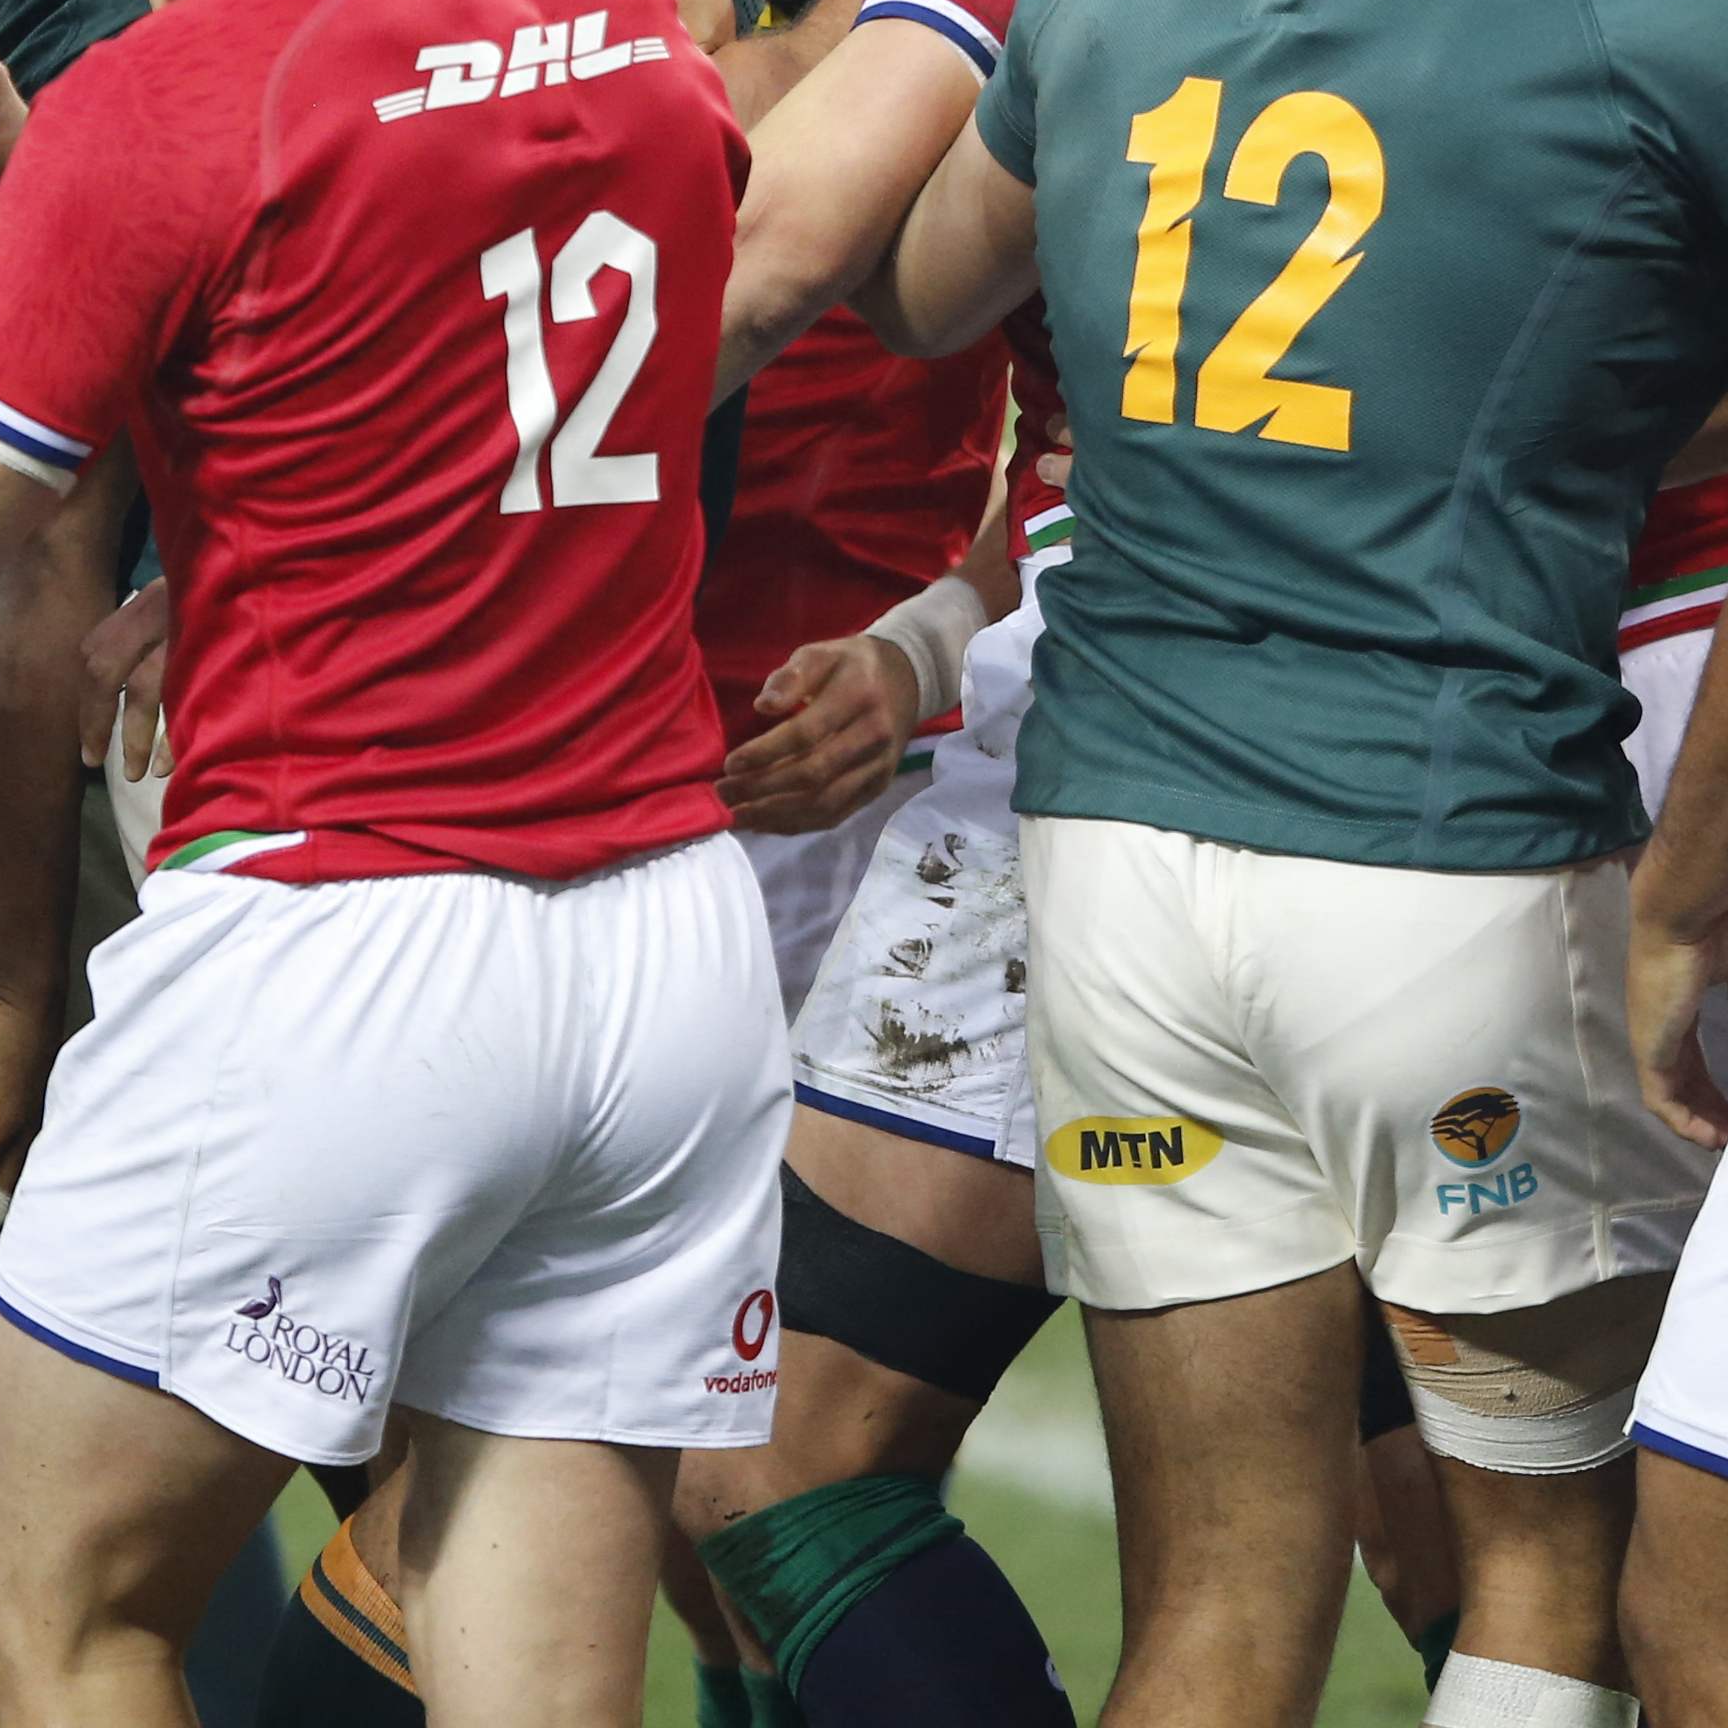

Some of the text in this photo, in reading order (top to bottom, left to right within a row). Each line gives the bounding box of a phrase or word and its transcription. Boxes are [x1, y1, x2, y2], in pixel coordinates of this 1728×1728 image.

[415, 9, 633, 110] DHL
[1121, 76, 1386, 452] 12
[480, 209, 661, 514] 12
[1080, 1125, 1184, 1171] MTN
[1436, 1162, 1539, 1216] FNB
[224, 1323, 373, 1405] LONDON
[272, 1313, 377, 1376] ROYAL
